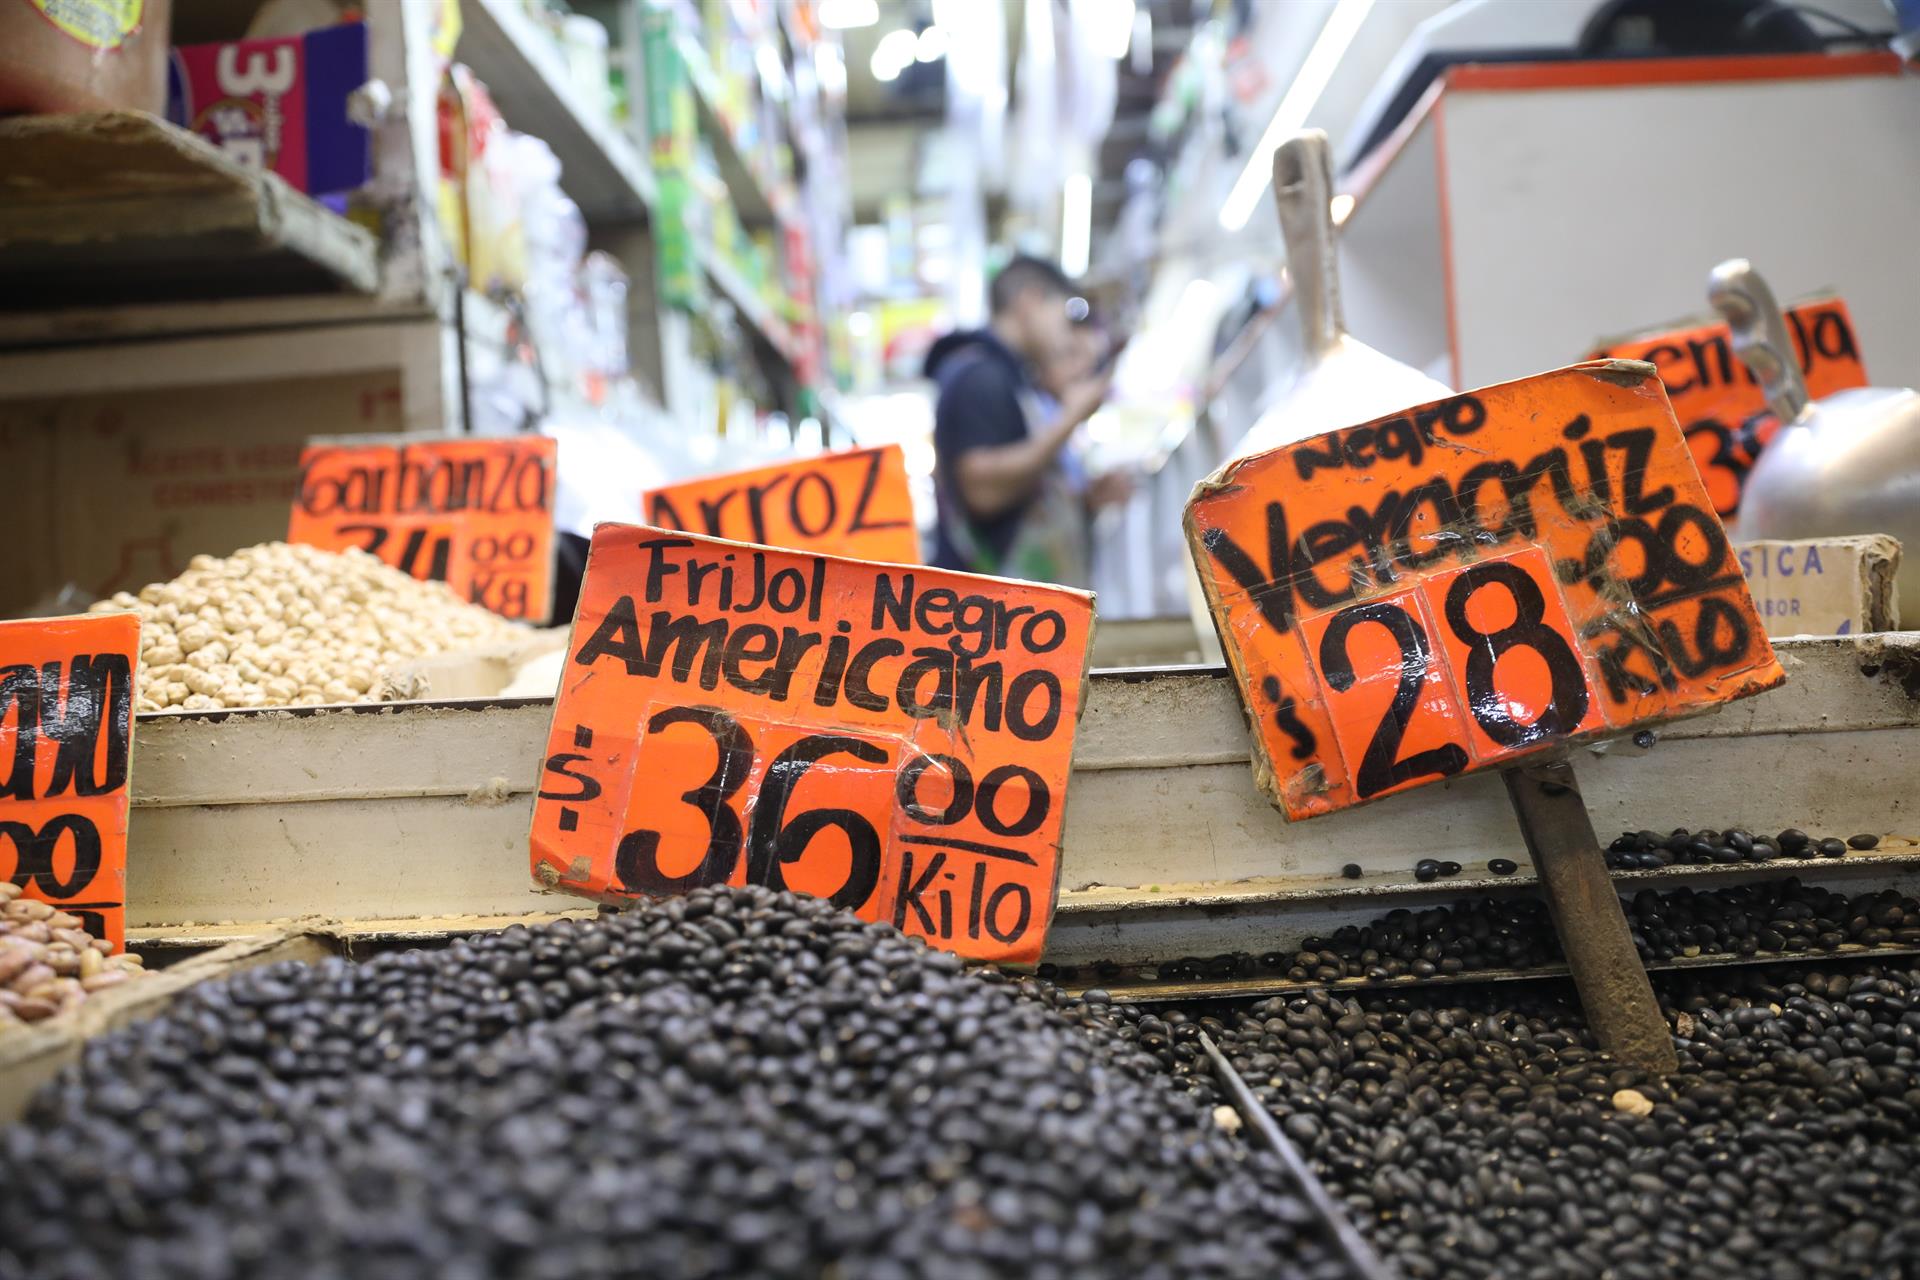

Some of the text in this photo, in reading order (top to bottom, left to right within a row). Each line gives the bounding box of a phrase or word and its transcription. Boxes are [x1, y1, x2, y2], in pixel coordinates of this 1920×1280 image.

[1292, 395, 1487, 481] Negro
[575, 595, 1063, 742] Americano
[871, 573, 1067, 660] Negro
[1319, 561, 1590, 798] 28
[615, 704, 891, 914] 36
[900, 851, 1032, 944] Kilo
